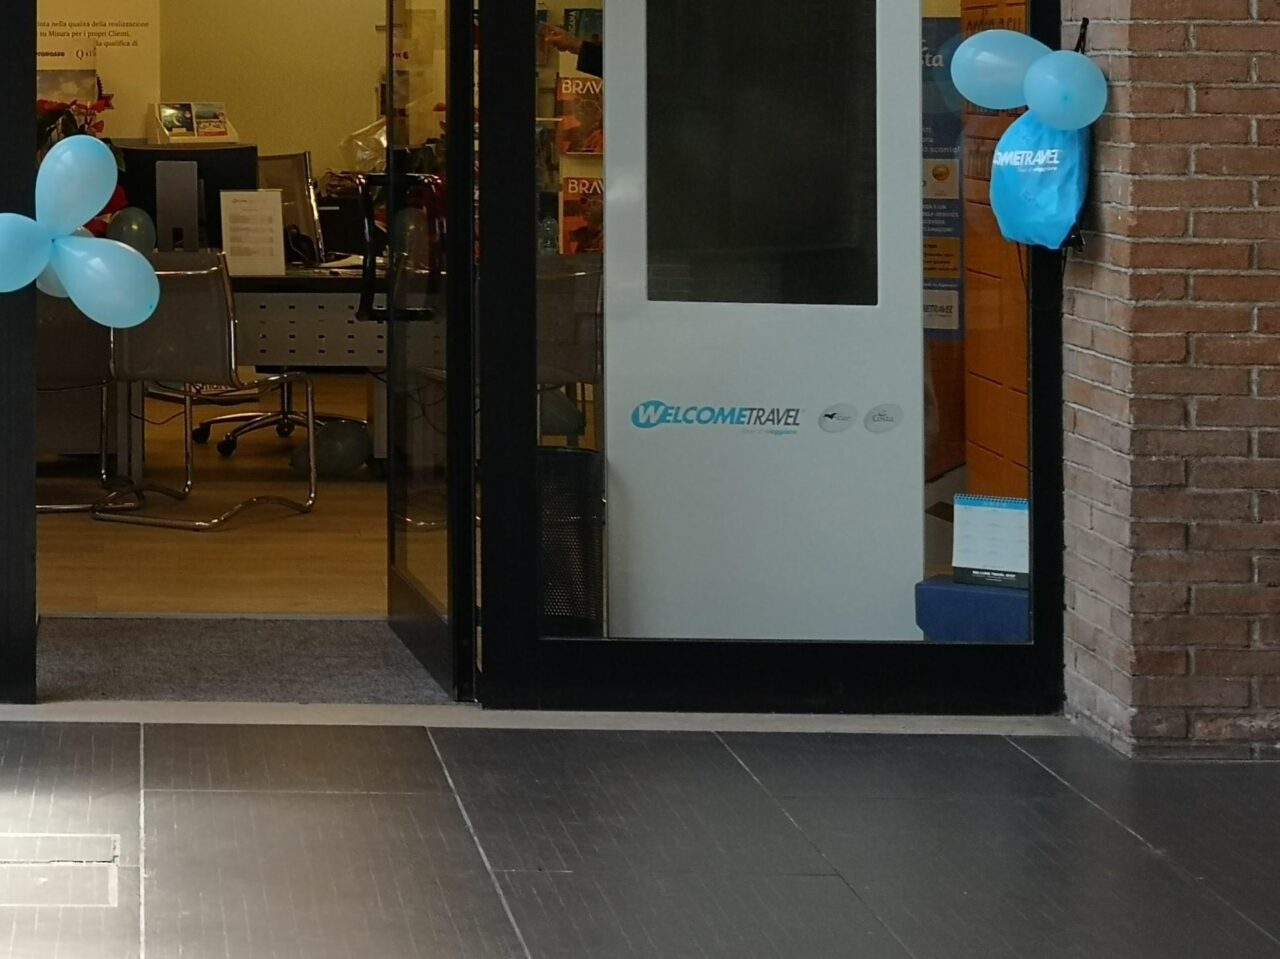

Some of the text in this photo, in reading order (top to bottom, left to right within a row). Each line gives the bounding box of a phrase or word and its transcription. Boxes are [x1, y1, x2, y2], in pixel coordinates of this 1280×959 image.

[87, 31, 107, 39] propri
[103, 40, 130, 48] qualifica
[634, 402, 802, 427] WELCOMETRAVEL
